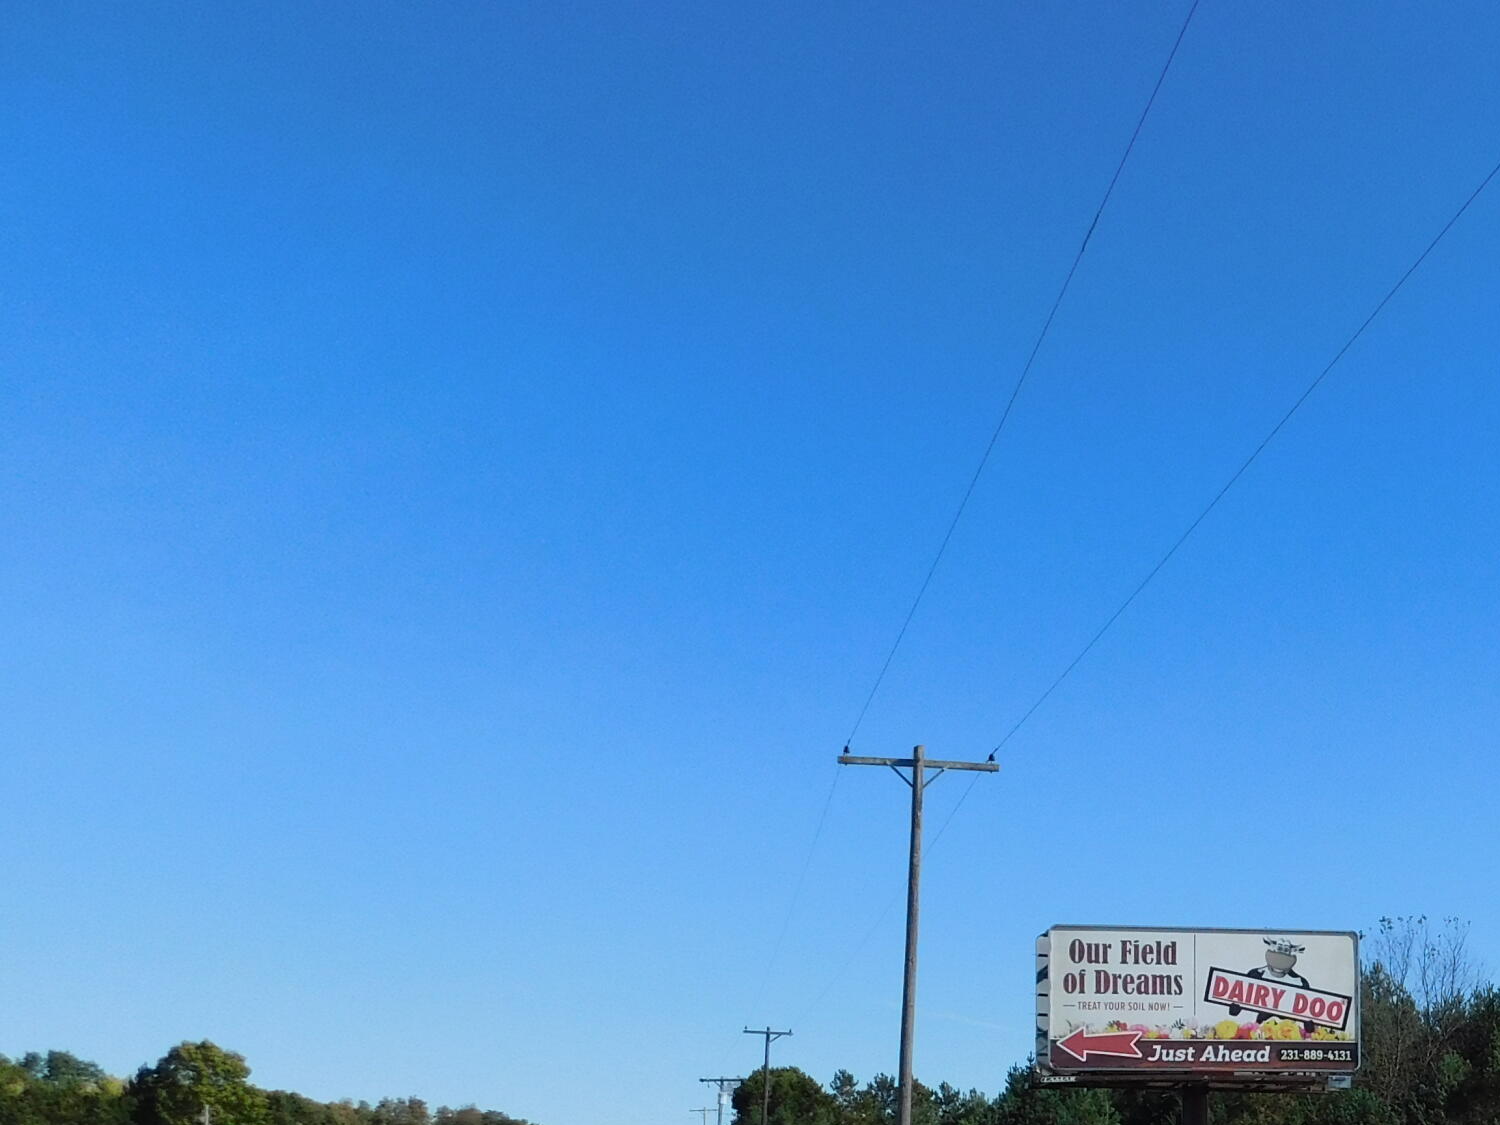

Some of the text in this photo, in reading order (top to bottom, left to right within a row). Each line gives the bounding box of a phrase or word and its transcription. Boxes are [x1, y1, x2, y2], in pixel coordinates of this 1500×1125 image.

[1069, 939, 1177, 965] Our Field
[1063, 969, 1183, 995] of Dreams
[1078, 1001, 1170, 1012] TREAT YOUR SOIL NOW!
[1212, 975, 1343, 1021] DAIRY DOO
[1147, 1045, 1271, 1062] Just Ahead
[1280, 1049, 1352, 1061] 231-889-4131
